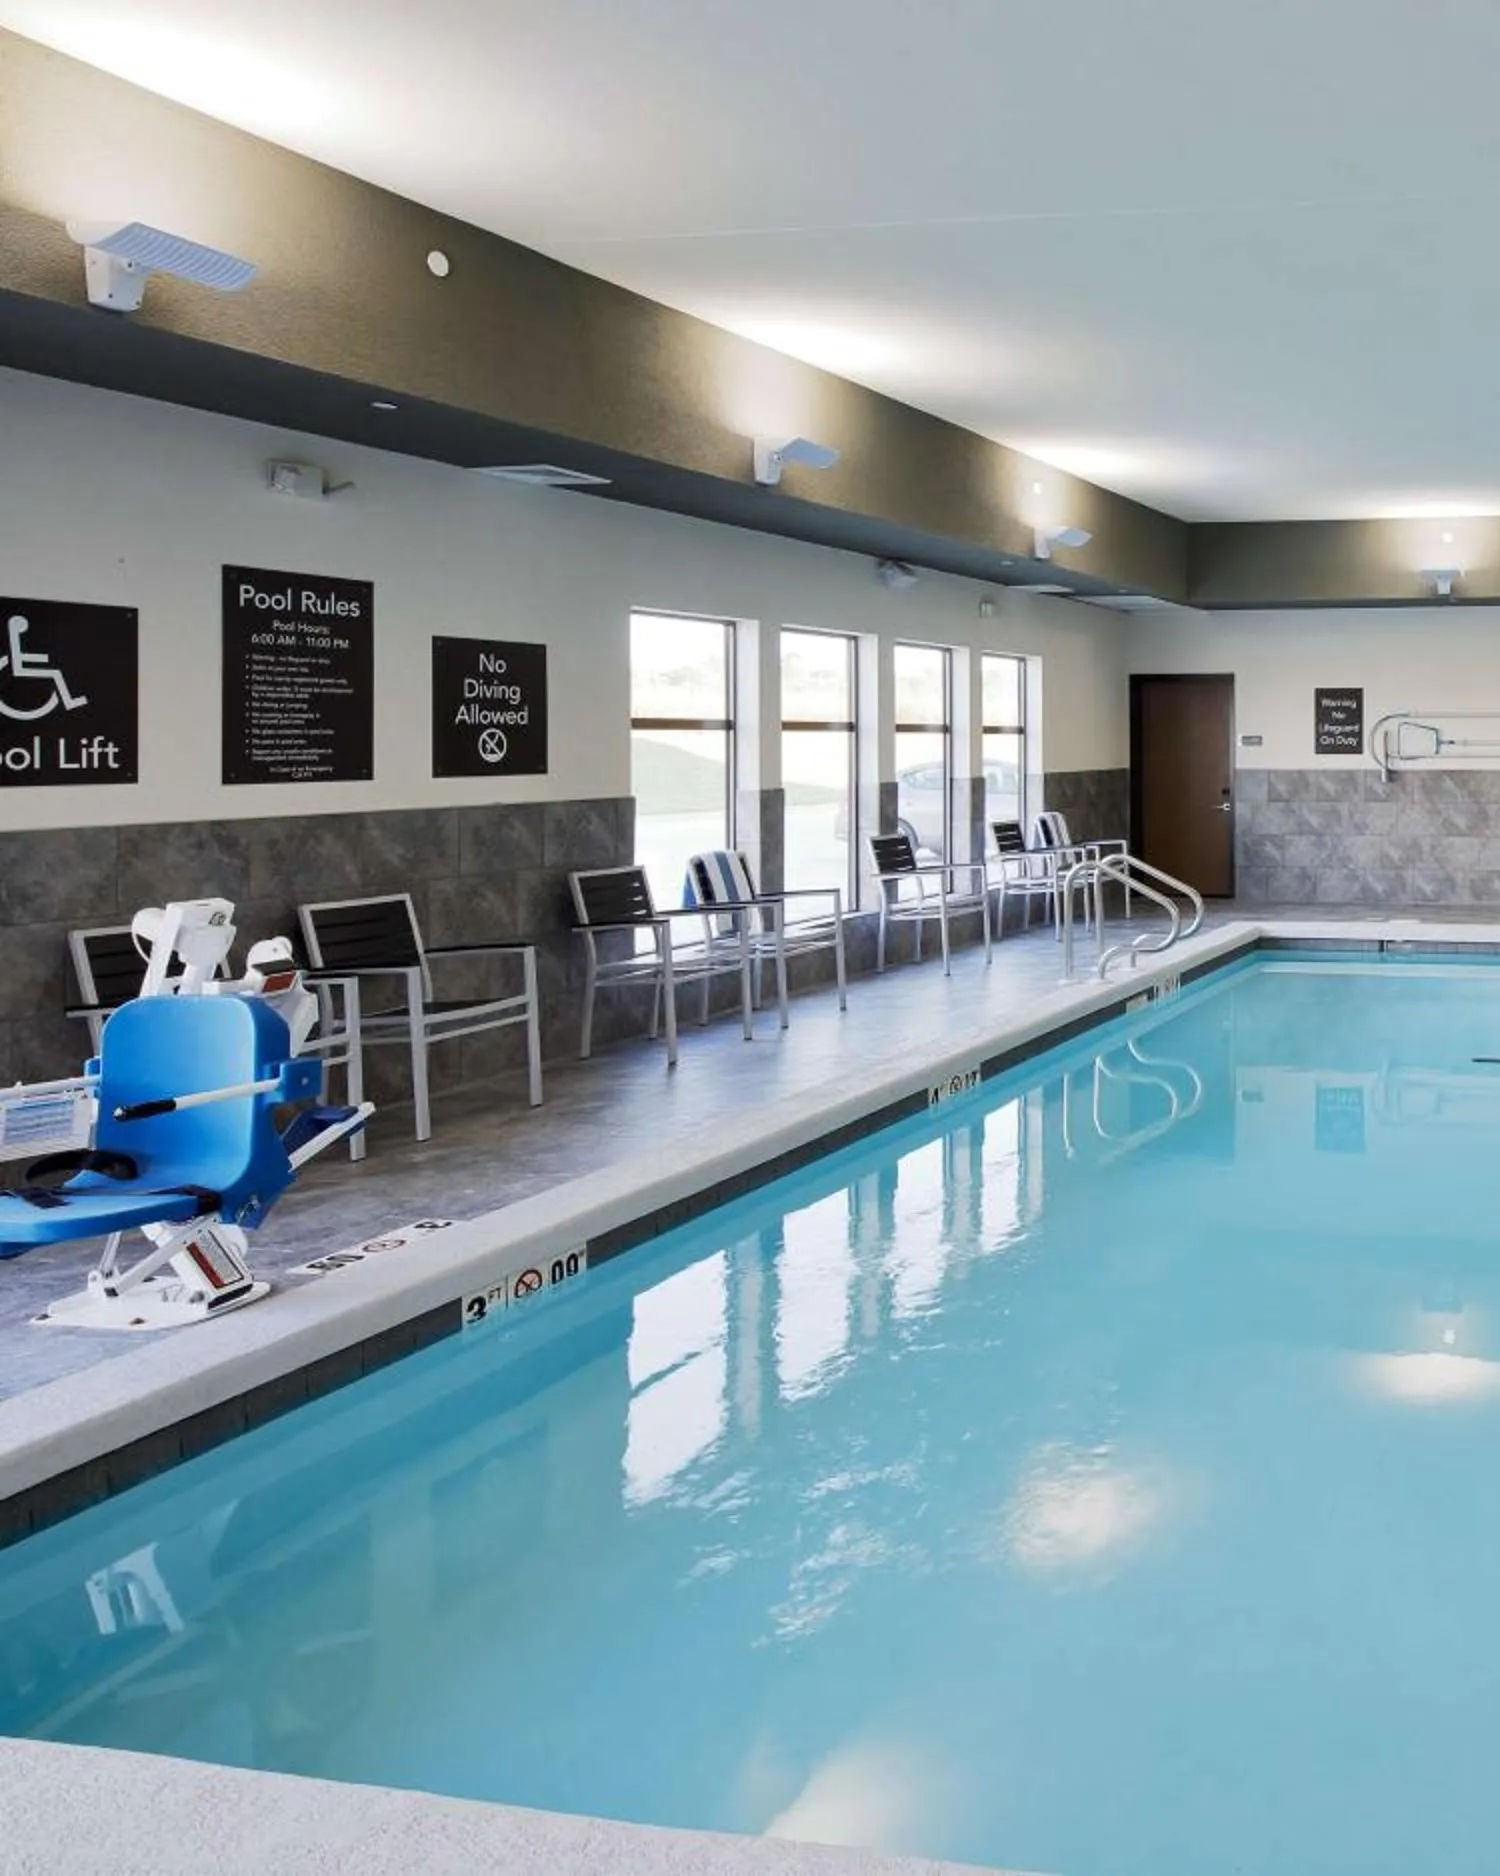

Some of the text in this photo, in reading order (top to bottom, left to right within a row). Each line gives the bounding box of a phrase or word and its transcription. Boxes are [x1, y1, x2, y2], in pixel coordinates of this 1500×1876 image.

[239, 584, 361, 617] Pool Rules
[272, 619, 295, 632] Pool
[251, 633, 274, 645] 6:00
[276, 635, 296, 647] AM
[306, 636, 330, 648] 11:00
[333, 639, 349, 649] PM
[479, 653, 507, 673] No
[464, 678, 520, 705] Diving
[455, 703, 529, 725] Allowed
[1320, 736, 1357, 747] On Duty
[0, 735, 120, 771] ol Lift
[466, 1296, 487, 1324] 3
